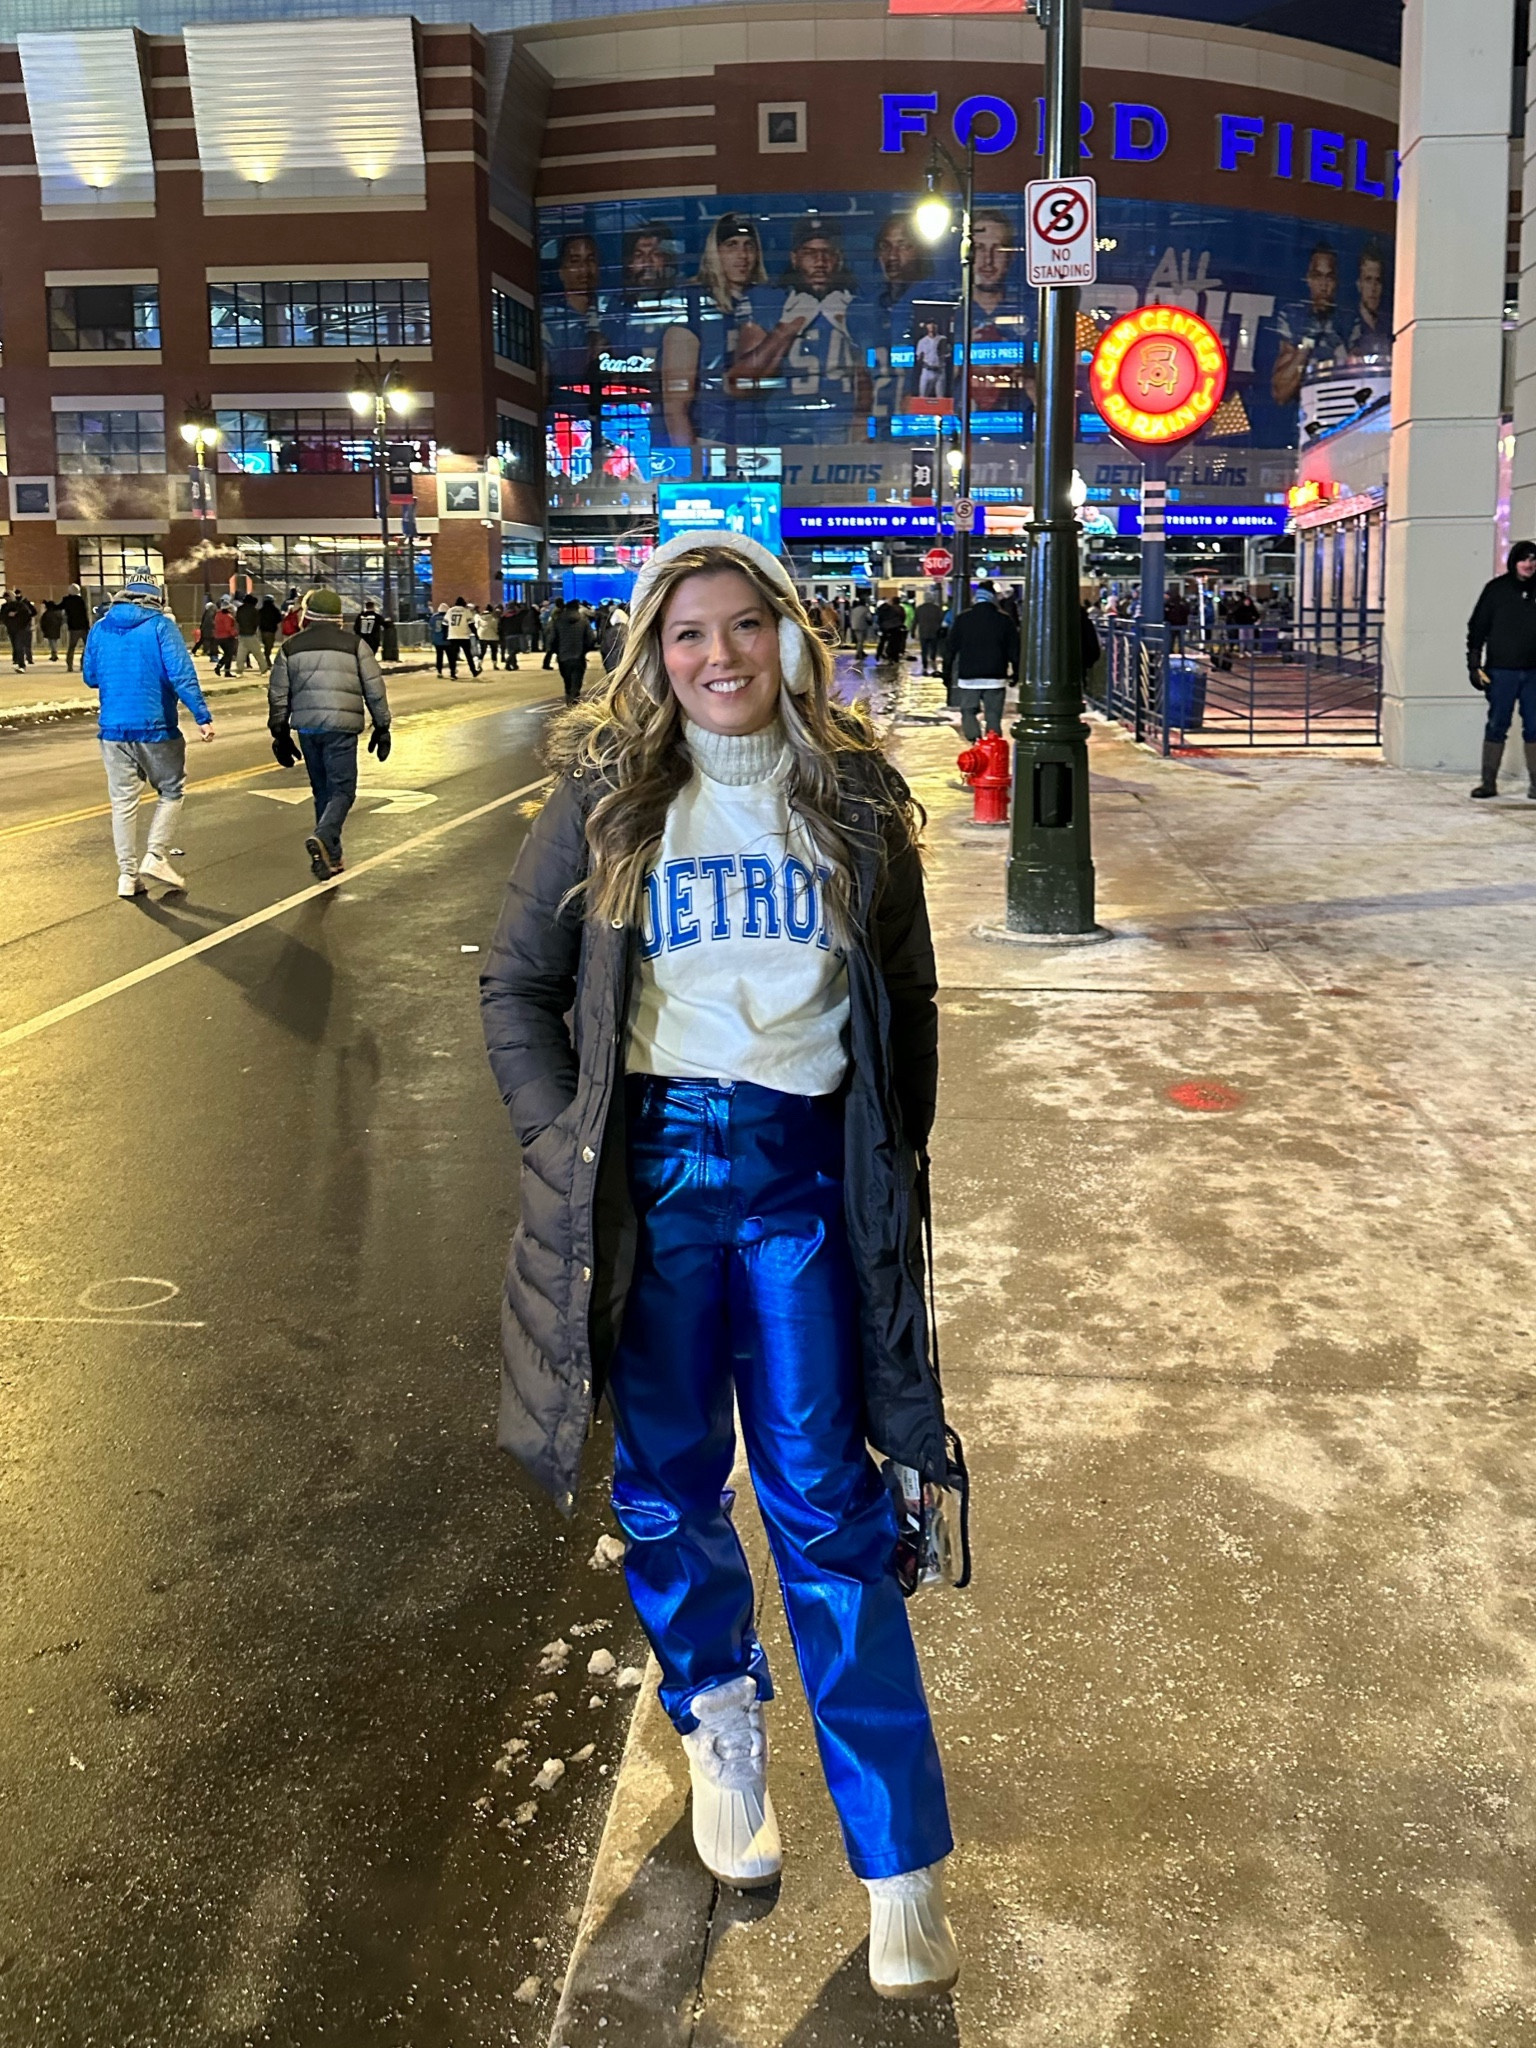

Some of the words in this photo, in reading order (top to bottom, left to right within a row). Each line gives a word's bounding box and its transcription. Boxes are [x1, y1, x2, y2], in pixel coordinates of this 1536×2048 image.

[1215, 112, 1401, 202] FIEL
[1051, 248, 1071, 261] NO
[1033, 263, 1090, 279] STANDING
[1150, 246, 1223, 294] ALL
[1095, 321, 1139, 390] GEM
[1138, 309, 1222, 373] CENTER
[1103, 377, 1216, 439] PARKING
[1095, 465, 1185, 485] DETIT
[800, 517, 822, 526] THE
[827, 517, 887, 526] STRENGTH
[891, 516, 907, 526] OF
[1166, 516, 1212, 525] TRENGTH
[1215, 516, 1229, 525] OF
[925, 557, 950, 569] STOP
[642, 854, 842, 962] DETROI
